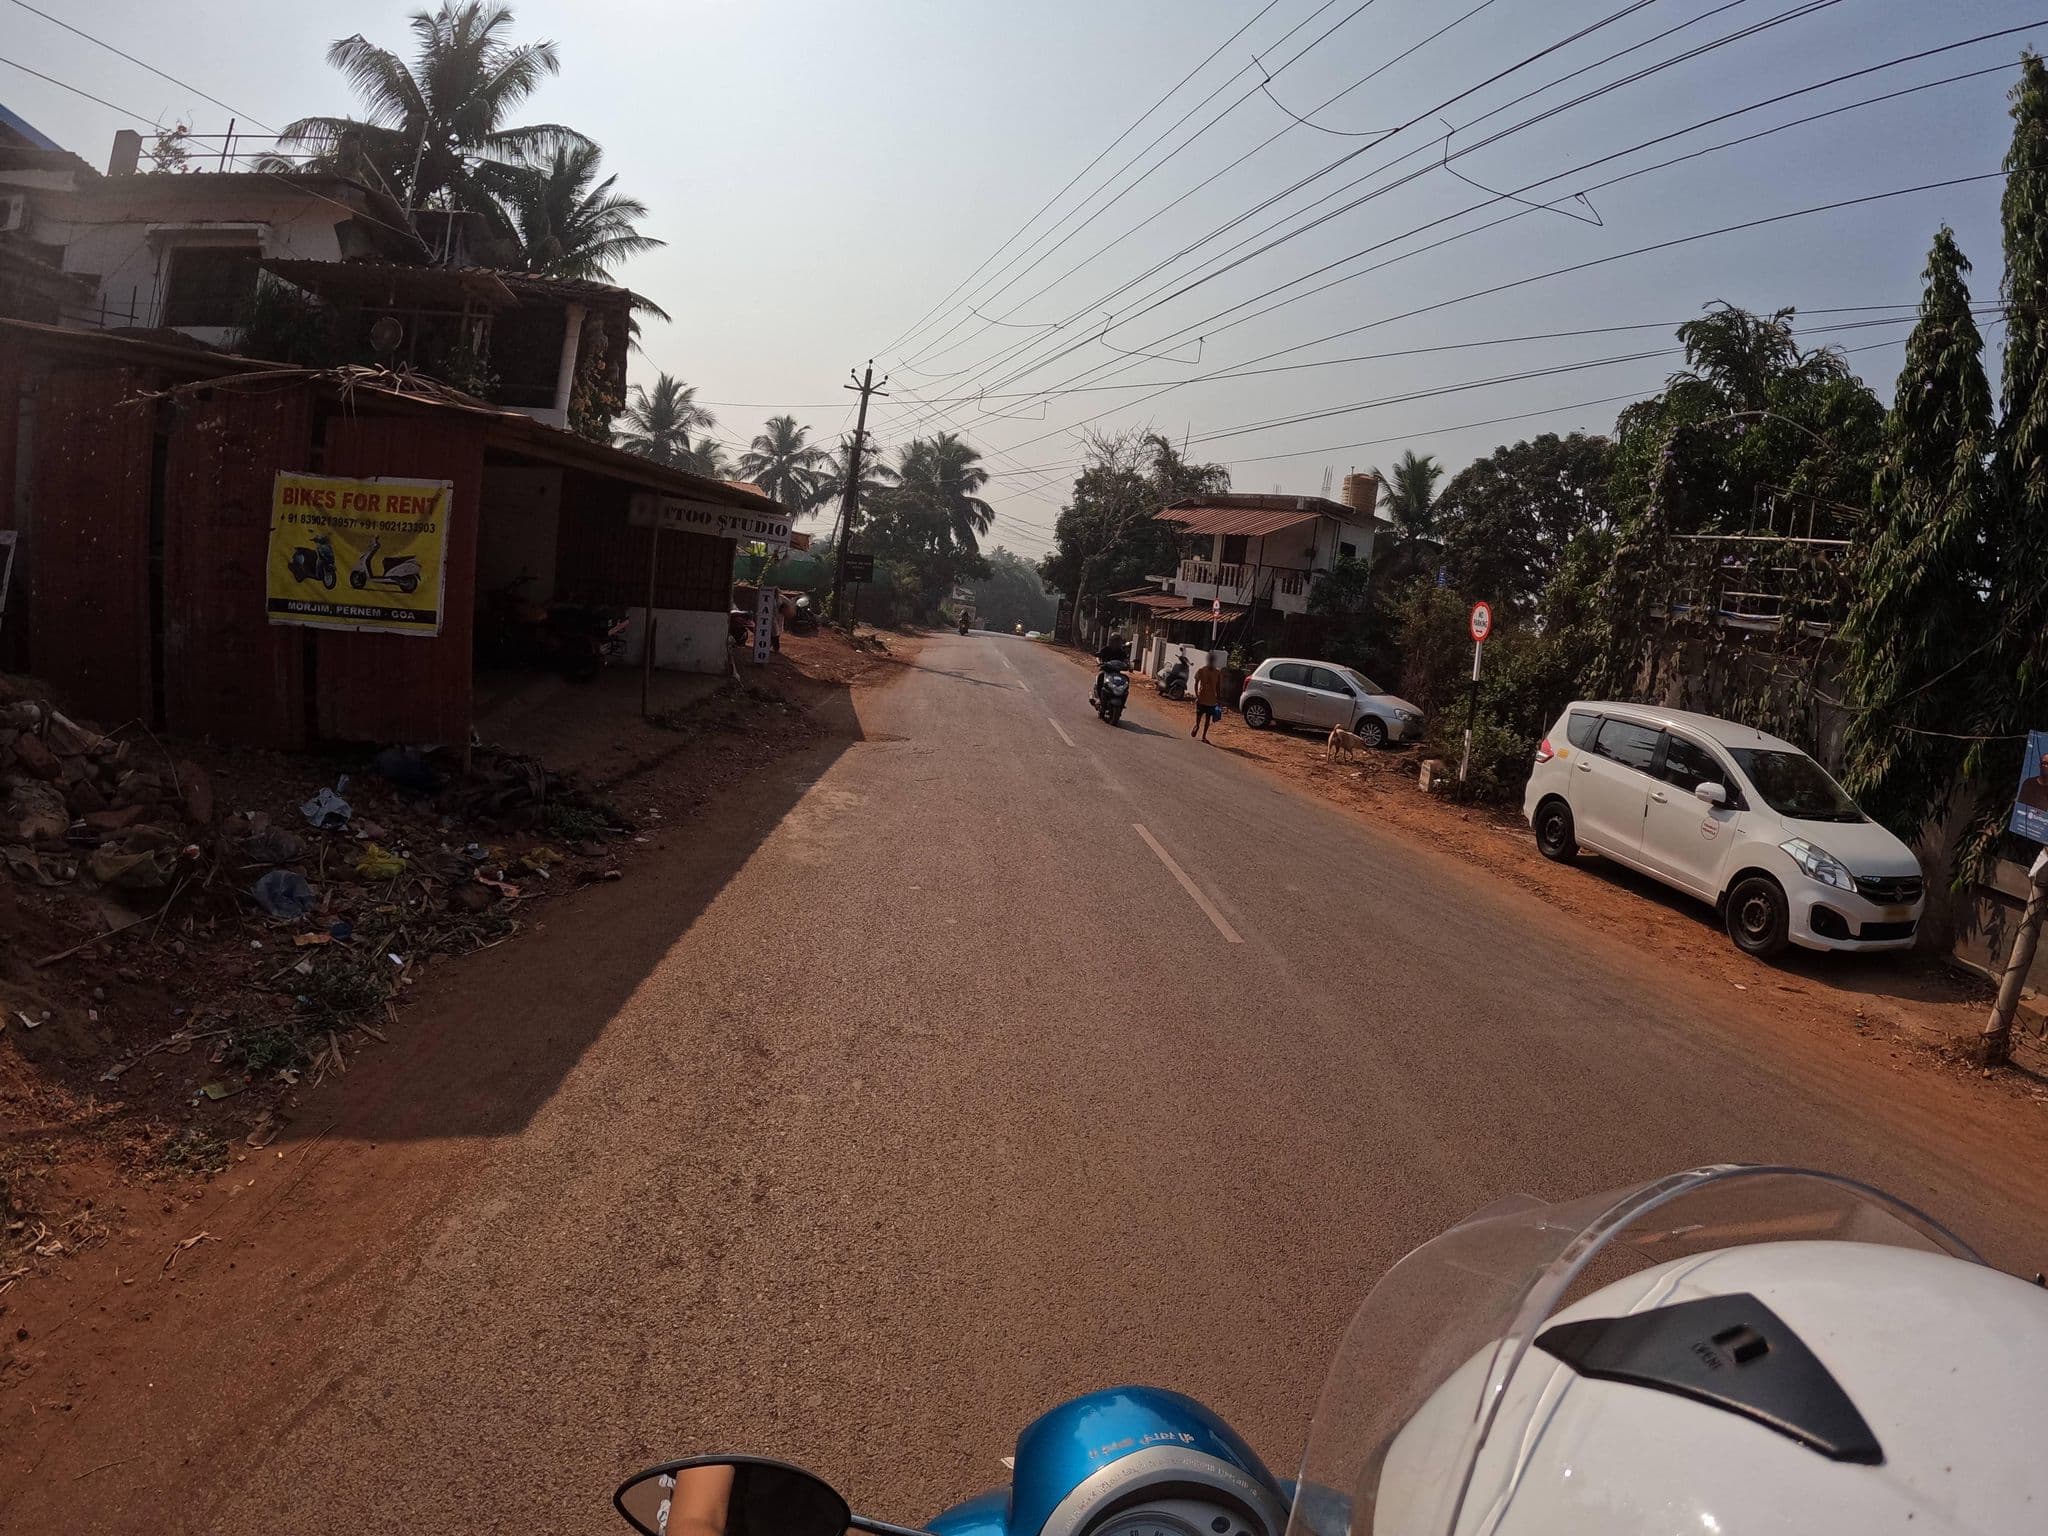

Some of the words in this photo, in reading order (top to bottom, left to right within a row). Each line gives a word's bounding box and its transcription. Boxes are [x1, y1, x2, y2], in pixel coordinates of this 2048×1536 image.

[282, 487, 336, 509] BIKES
[342, 492, 381, 512] FOR
[386, 495, 438, 515] RENT
[287, 513, 297, 523] 91
[716, 513, 788, 537] STUDIO
[287, 601, 333, 614] MORJIM,
[336, 604, 381, 617] PERNEM
[391, 609, 416, 621] GOA
[757, 594, 771, 660] TATTOO
